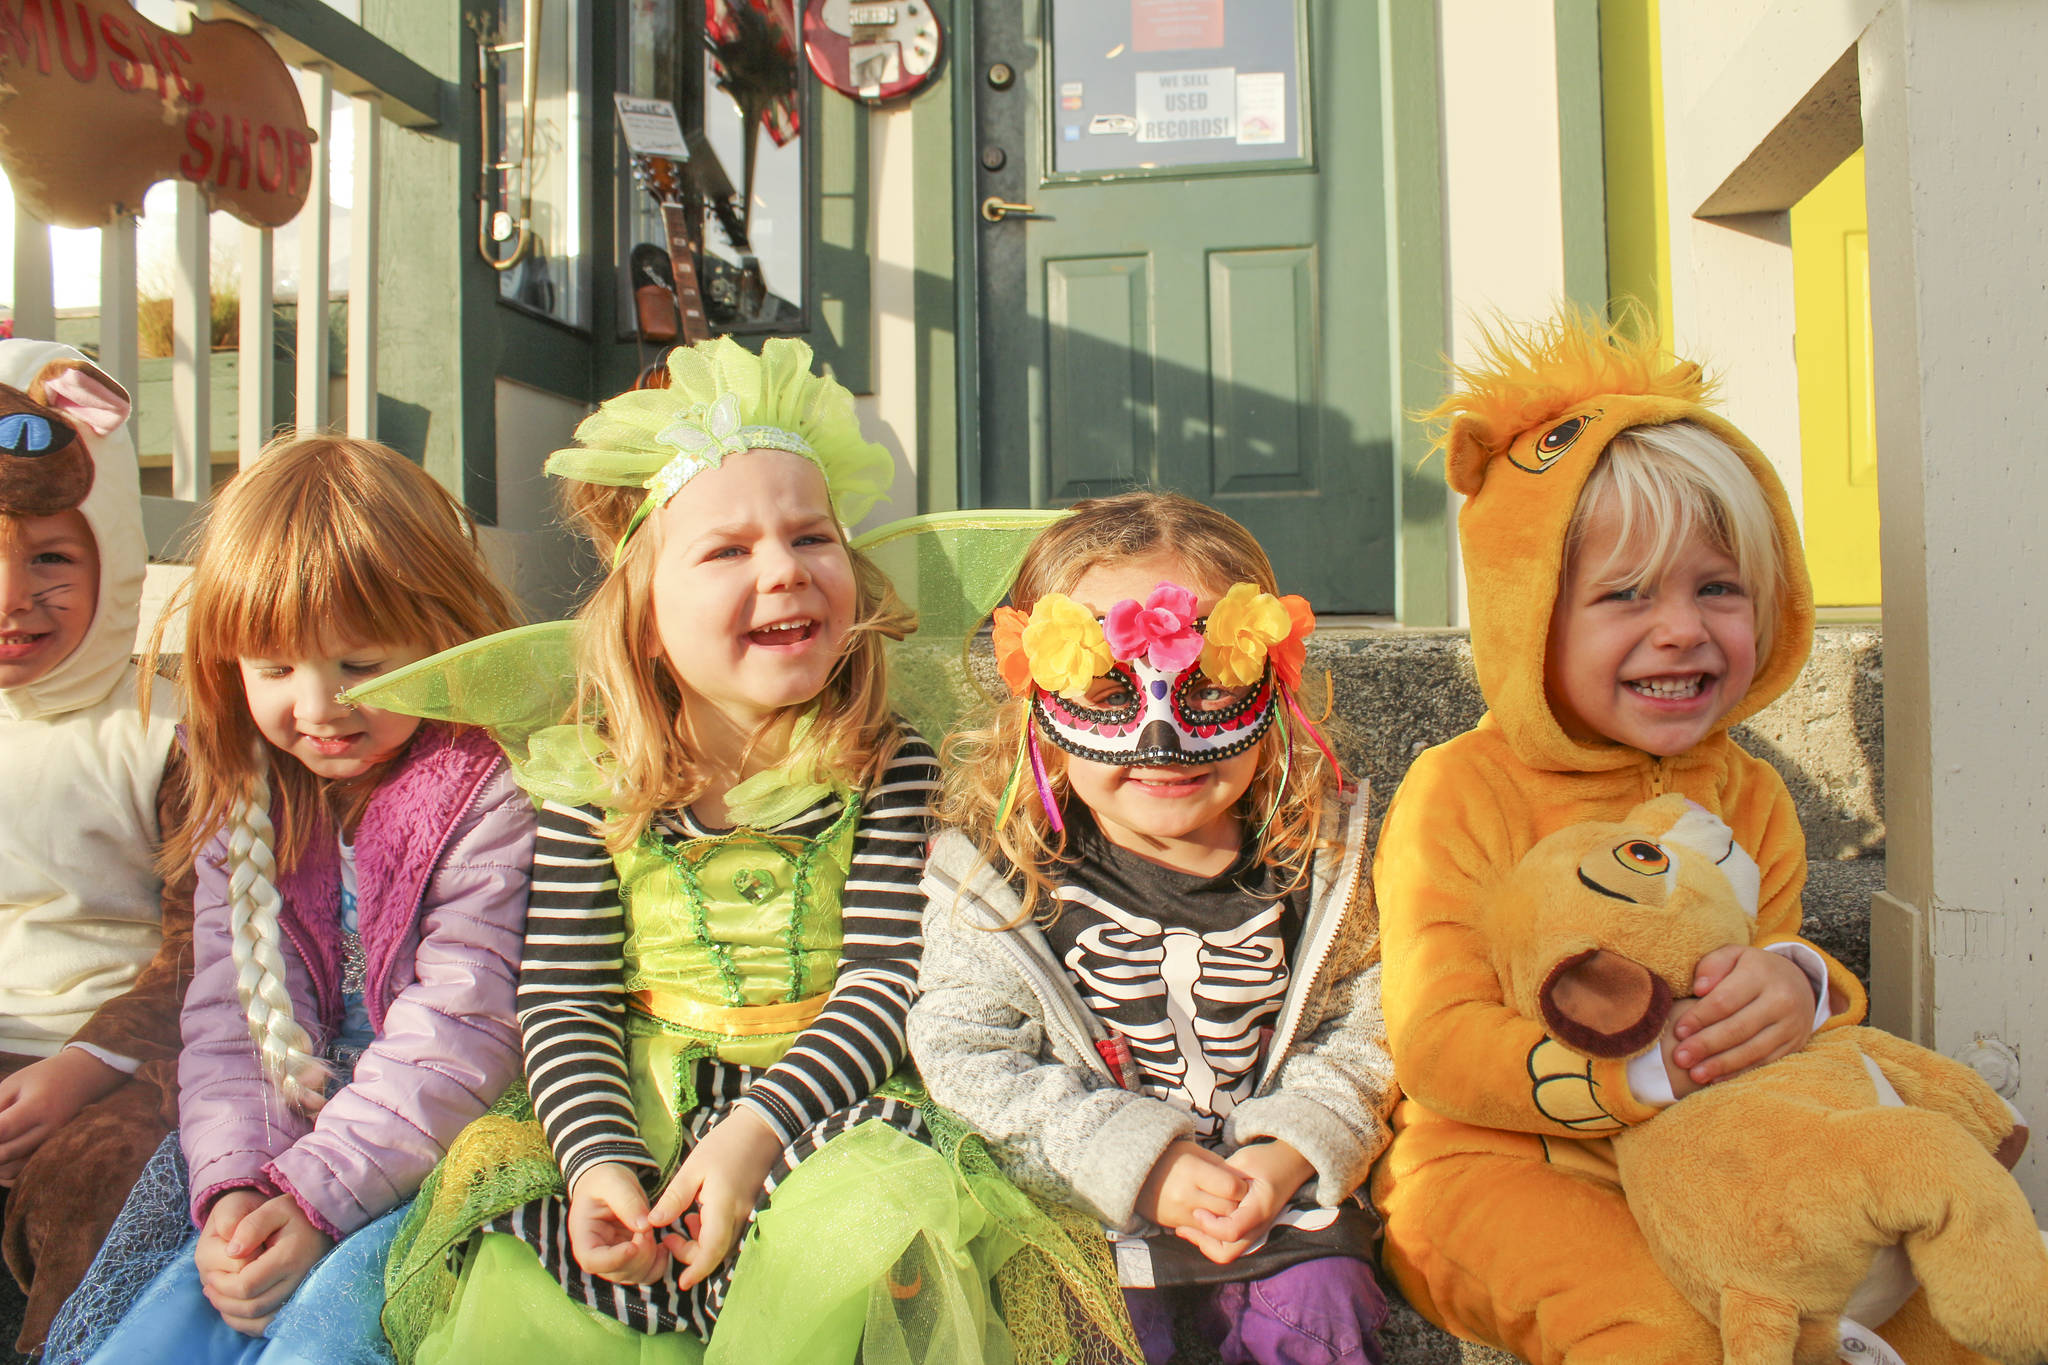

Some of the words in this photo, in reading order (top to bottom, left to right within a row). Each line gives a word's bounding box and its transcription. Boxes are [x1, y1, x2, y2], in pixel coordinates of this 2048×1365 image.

[0, 0, 204, 105] MUSIC
[1159, 75, 1178, 88] WE
[1182, 73, 1209, 87] SELL
[1165, 92, 1208, 112] USED
[1146, 117, 1229, 139] RECORDS!
[180, 109, 310, 196] SHOP
